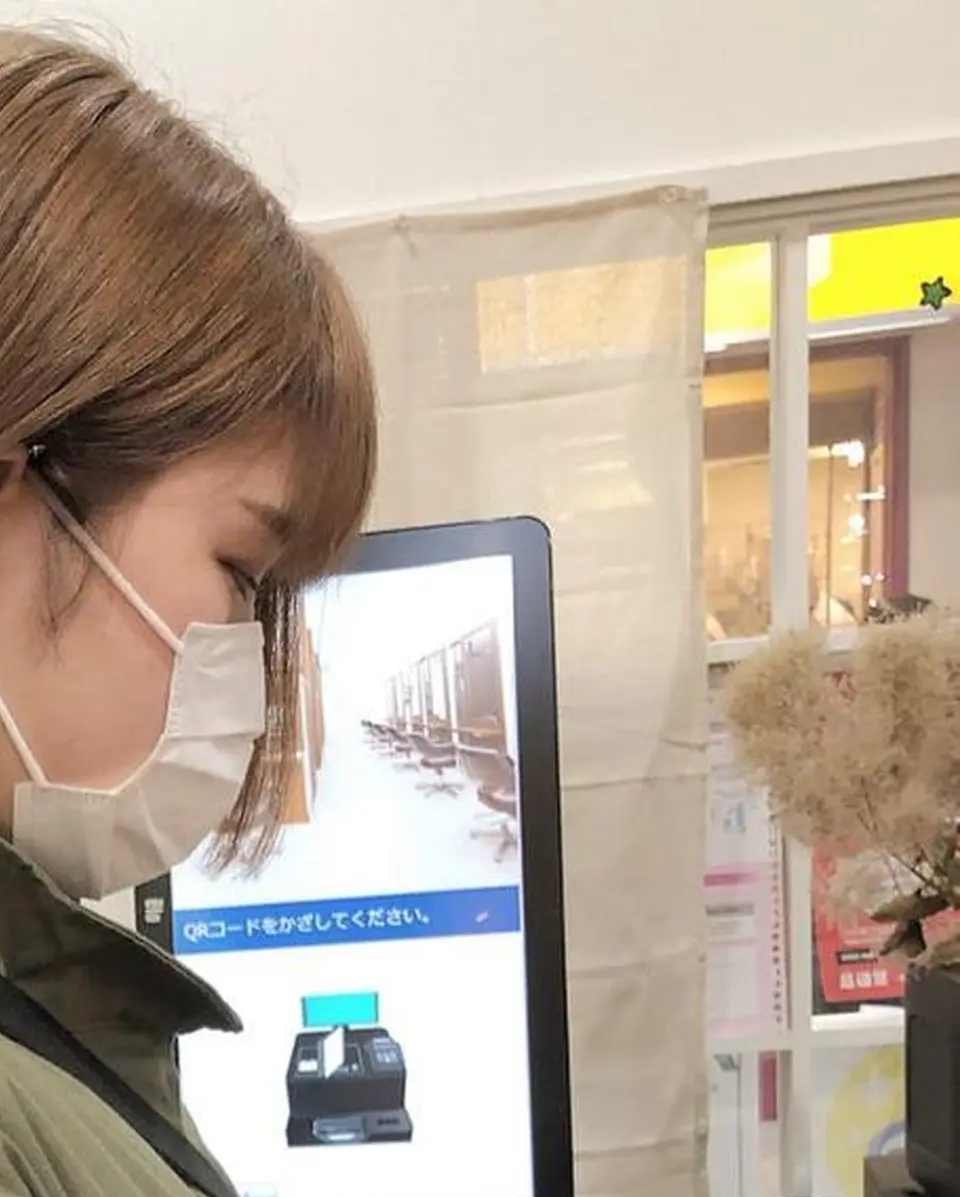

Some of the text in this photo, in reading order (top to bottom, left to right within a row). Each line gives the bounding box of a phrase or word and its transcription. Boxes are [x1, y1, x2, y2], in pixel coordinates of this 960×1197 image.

[183, 908, 430, 942] QRコードをかざしてください。
